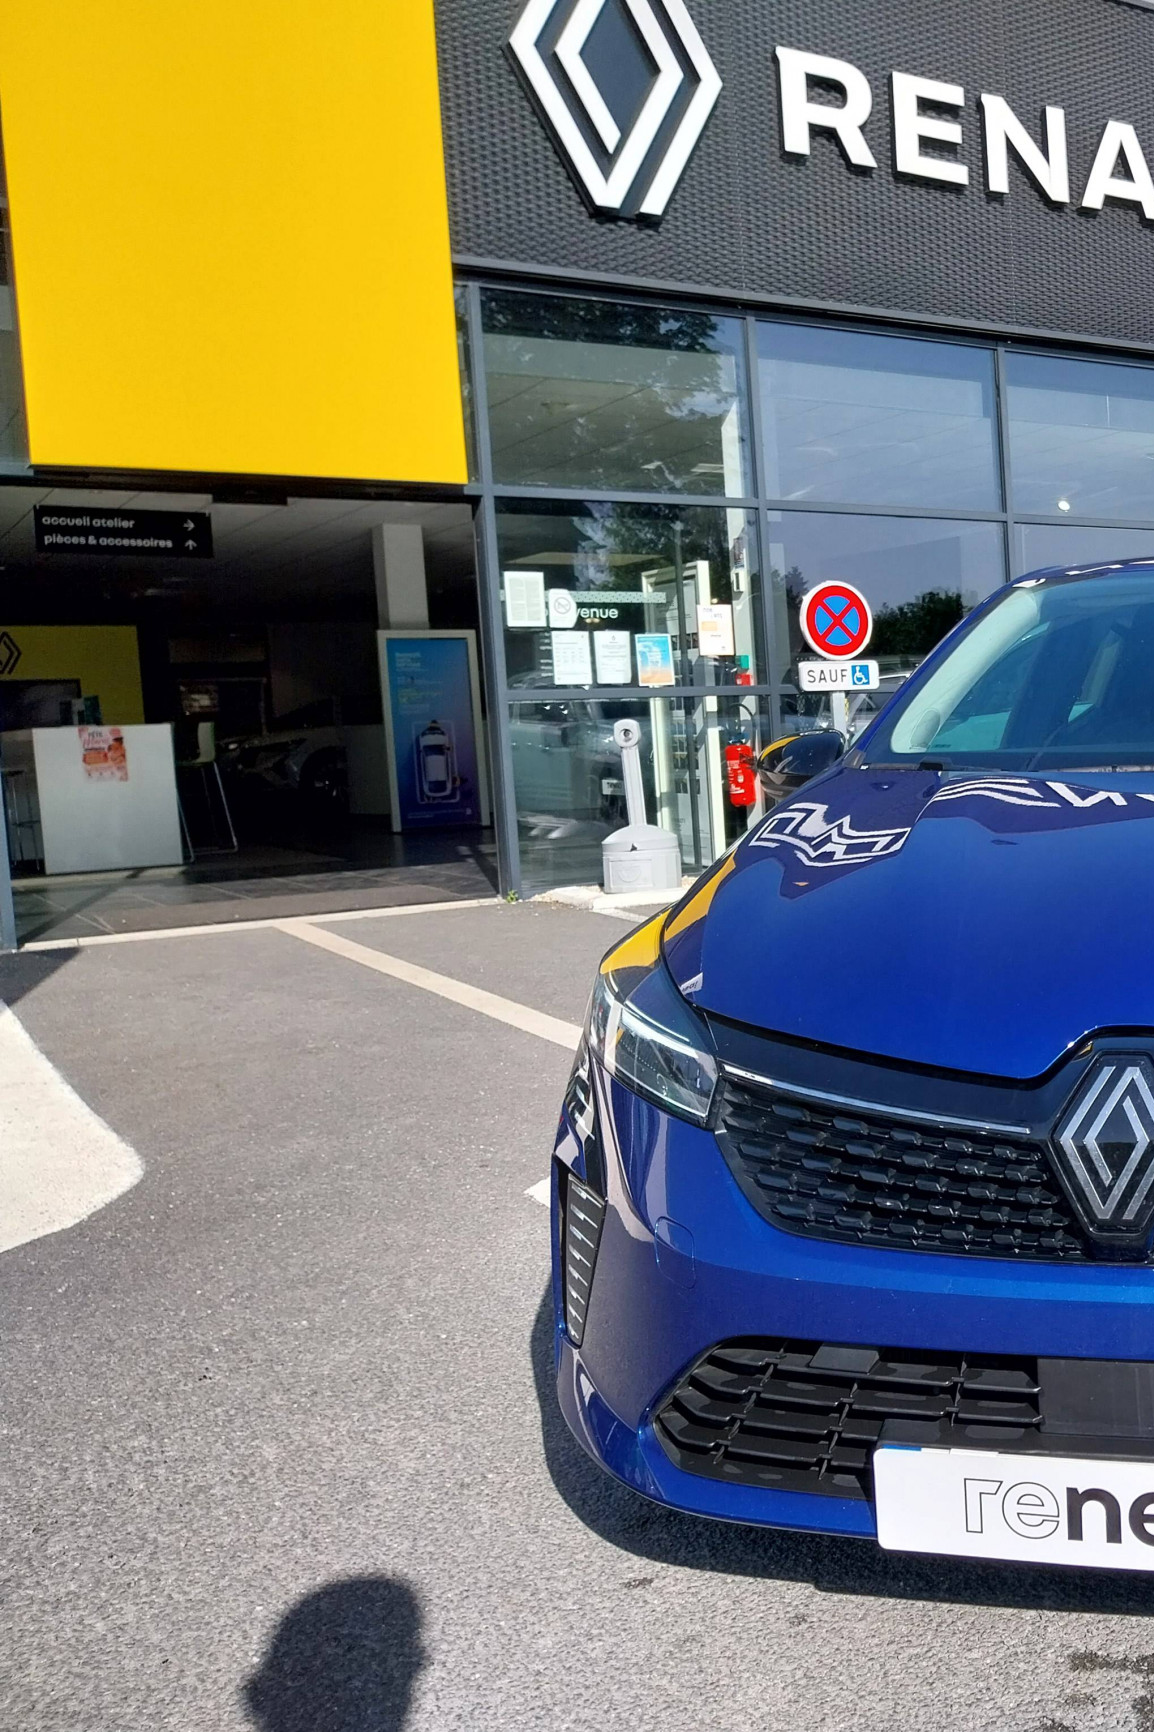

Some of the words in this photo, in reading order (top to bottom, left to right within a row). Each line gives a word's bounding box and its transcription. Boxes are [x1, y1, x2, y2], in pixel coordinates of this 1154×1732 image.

[42, 515, 91, 527] accueil
[92, 517, 135, 529] atelier
[44, 533, 86, 546] pièces
[88, 535, 97, 545] &
[99, 536, 173, 549] accessoires
[807, 669, 848, 684] SAUF
